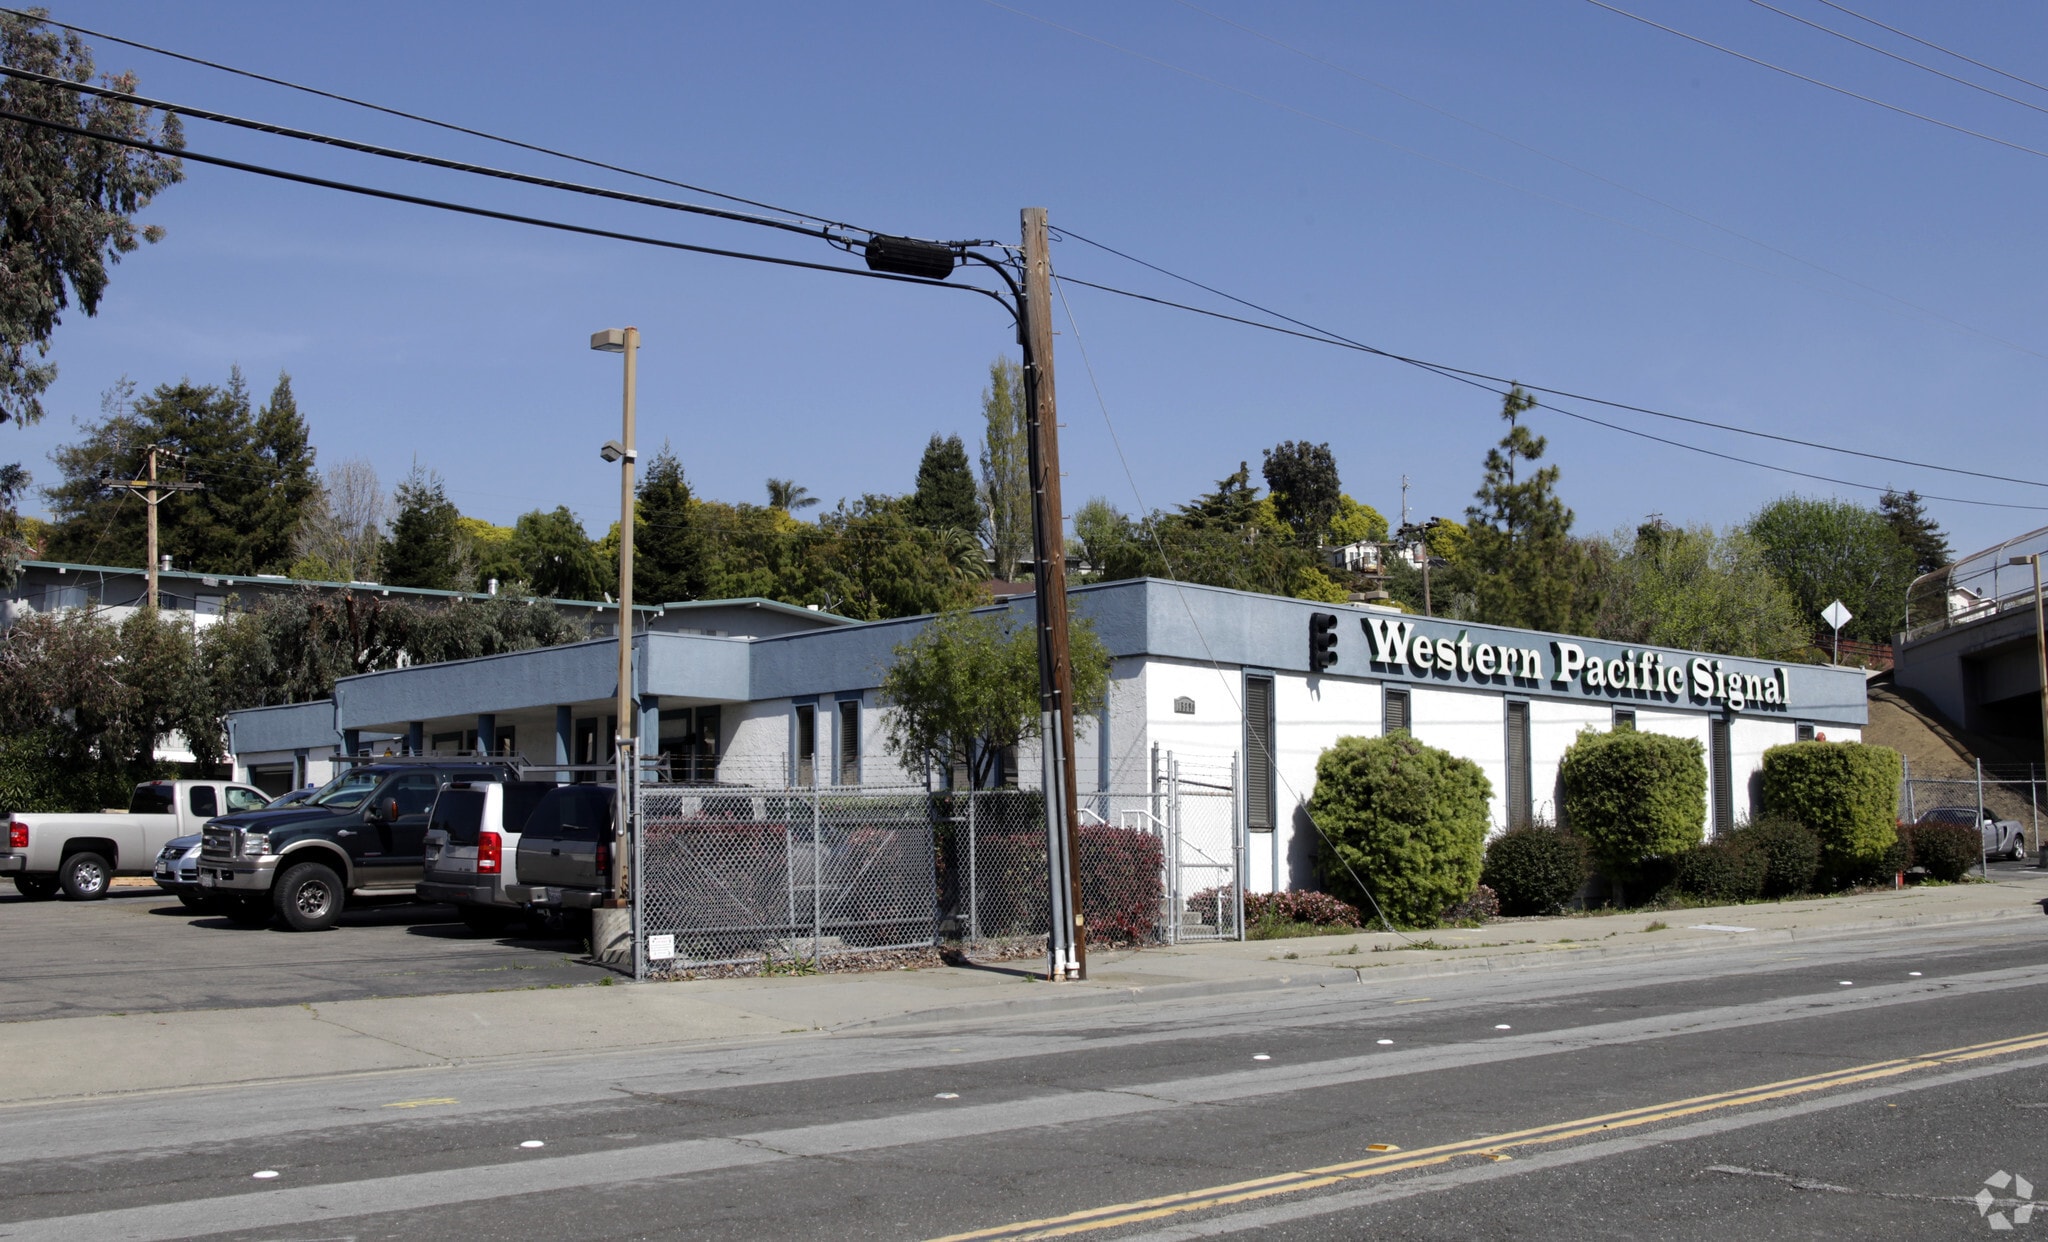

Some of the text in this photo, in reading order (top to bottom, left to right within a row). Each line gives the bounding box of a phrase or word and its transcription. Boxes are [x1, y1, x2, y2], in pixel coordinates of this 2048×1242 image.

[1362, 617, 1791, 711] Western Pacific Signal
